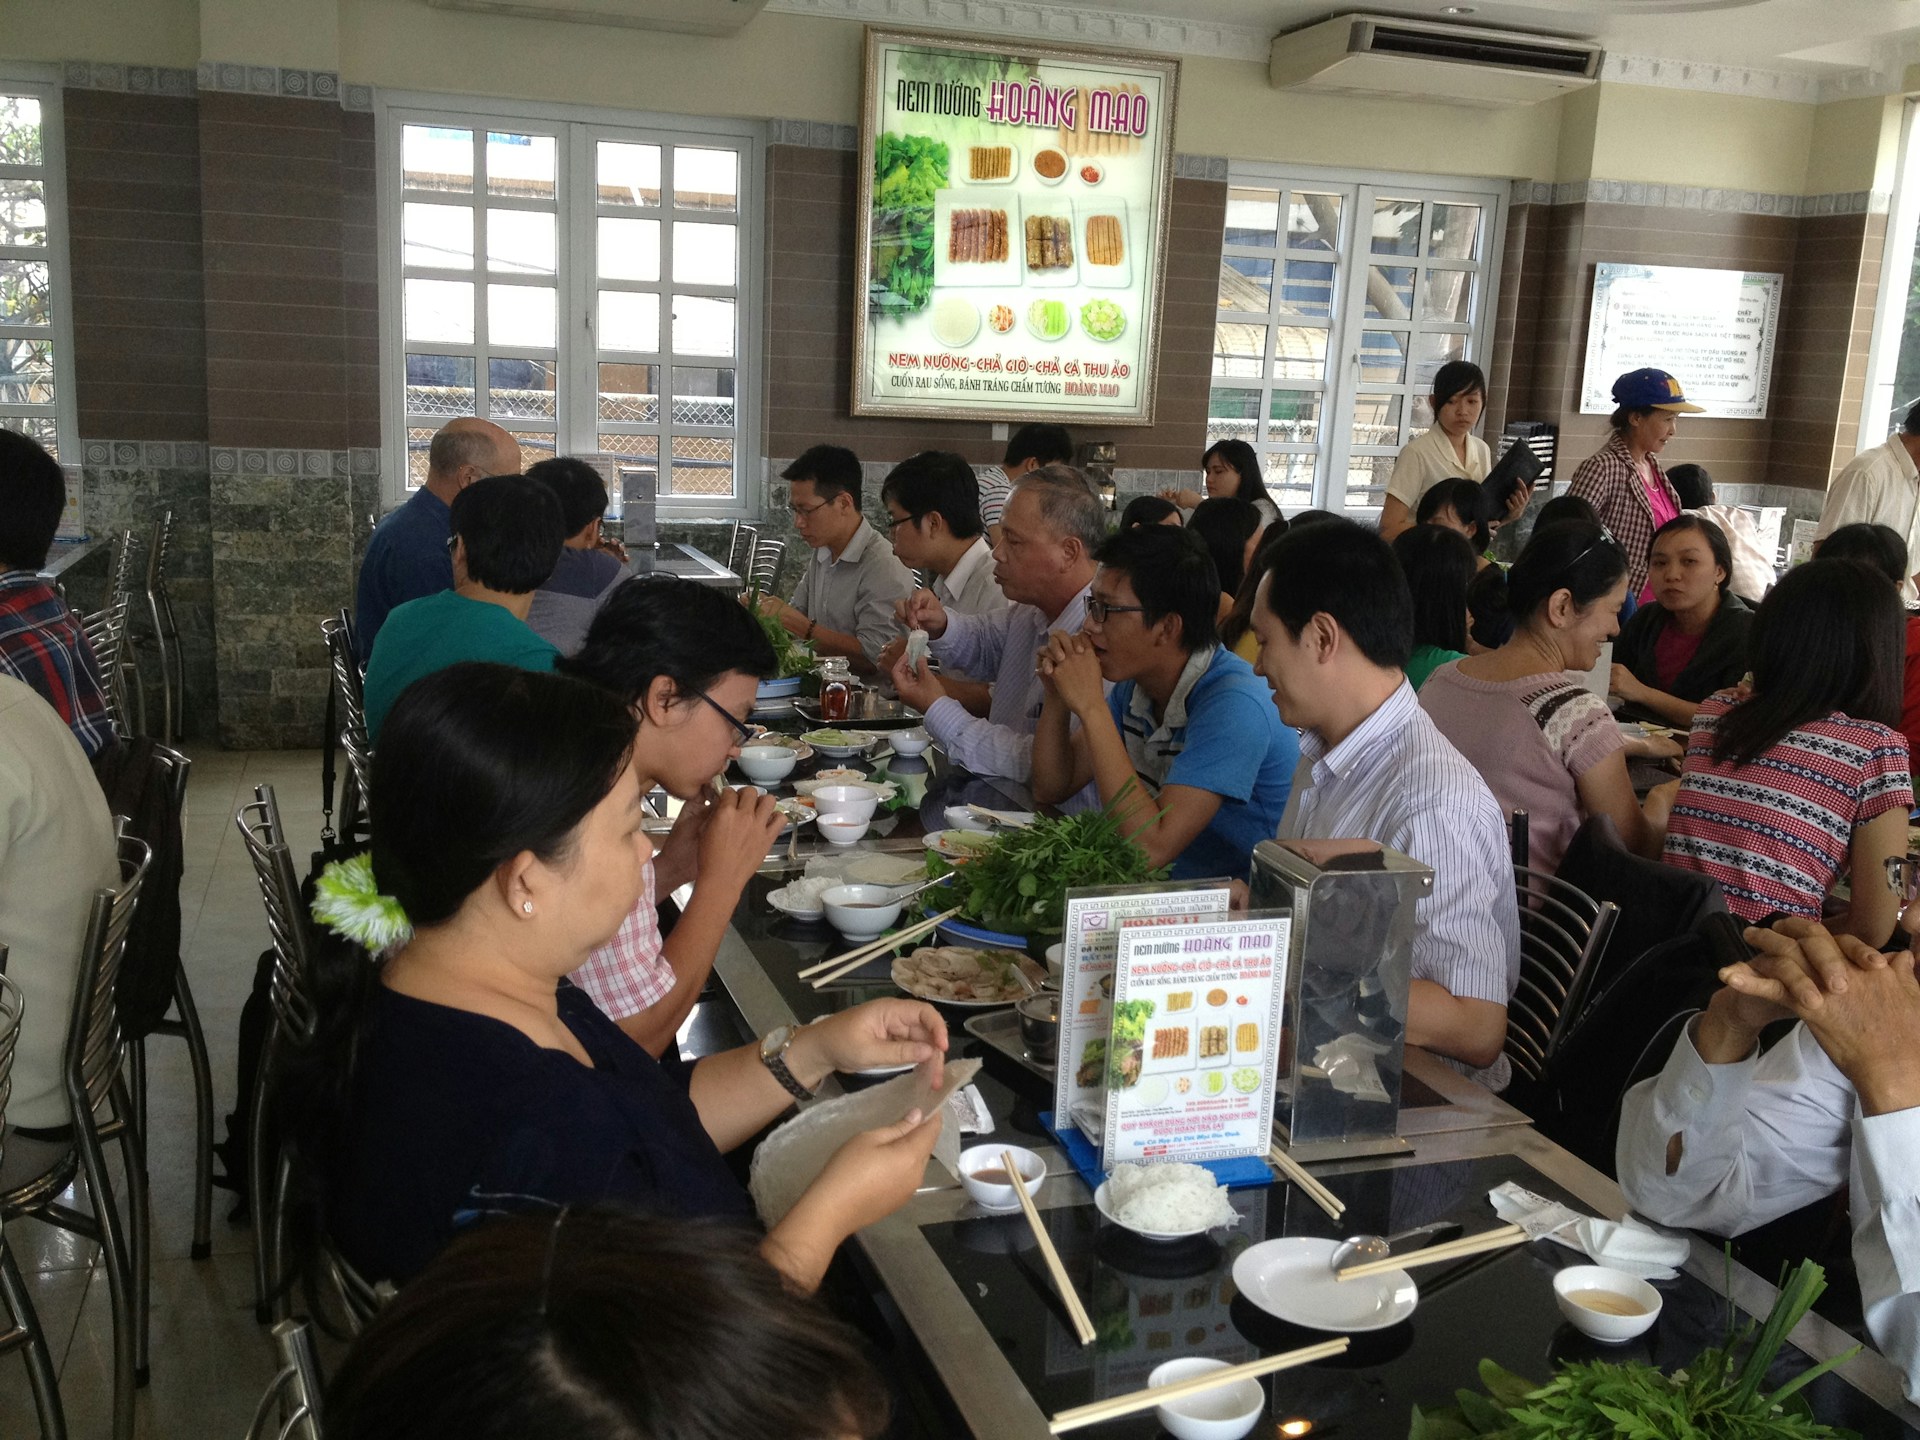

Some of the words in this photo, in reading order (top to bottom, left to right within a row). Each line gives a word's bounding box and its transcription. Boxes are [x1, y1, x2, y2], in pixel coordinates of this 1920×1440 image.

[897, 79, 930, 113] NEM
[984, 77, 1077, 130] HOÀNG
[1089, 90, 1148, 136] MAO
[889, 353, 920, 367] NEM
[1064, 359, 1080, 375] CÁ
[1083, 362, 1108, 377] THU
[916, 376, 932, 388] RAU
[959, 376, 980, 390] BÁNH
[1011, 377, 1033, 393] CHẤM
[1099, 382, 1120, 398] MAO
[1239, 934, 1271, 949] MAO
[1131, 965, 1149, 976] NEM
